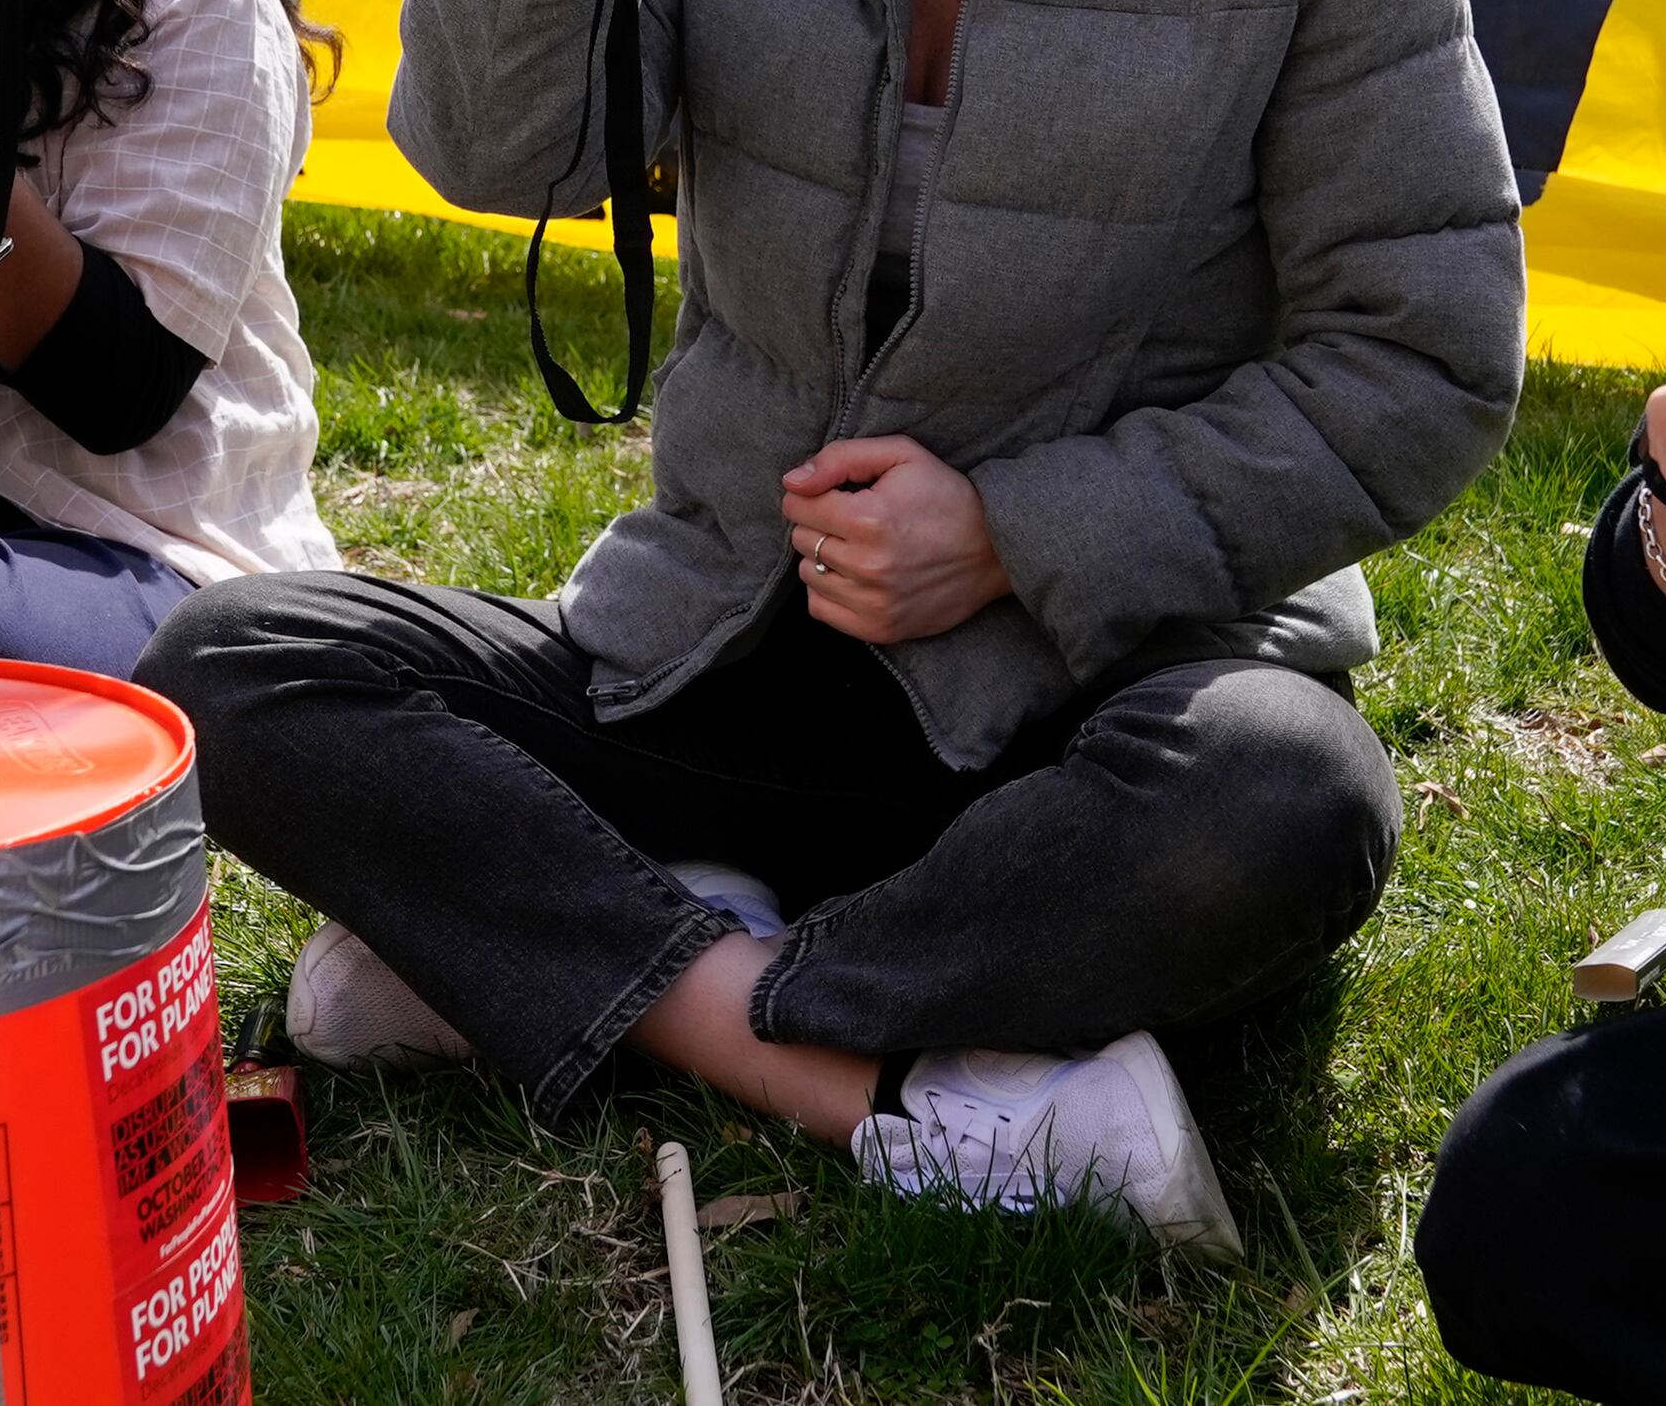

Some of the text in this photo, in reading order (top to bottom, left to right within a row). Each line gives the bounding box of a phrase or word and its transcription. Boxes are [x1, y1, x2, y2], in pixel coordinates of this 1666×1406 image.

[95, 914, 211, 1043] FOR PEOPLE
[99, 1020, 161, 1083] FOR
[161, 951, 214, 1044] PLANET
[136, 1149, 205, 1222] OCTOBER
[131, 1275, 188, 1343] FOR
[188, 1198, 238, 1299] PEOPLE
[135, 1319, 190, 1382] FOR
[192, 1235, 239, 1335] PLANET
